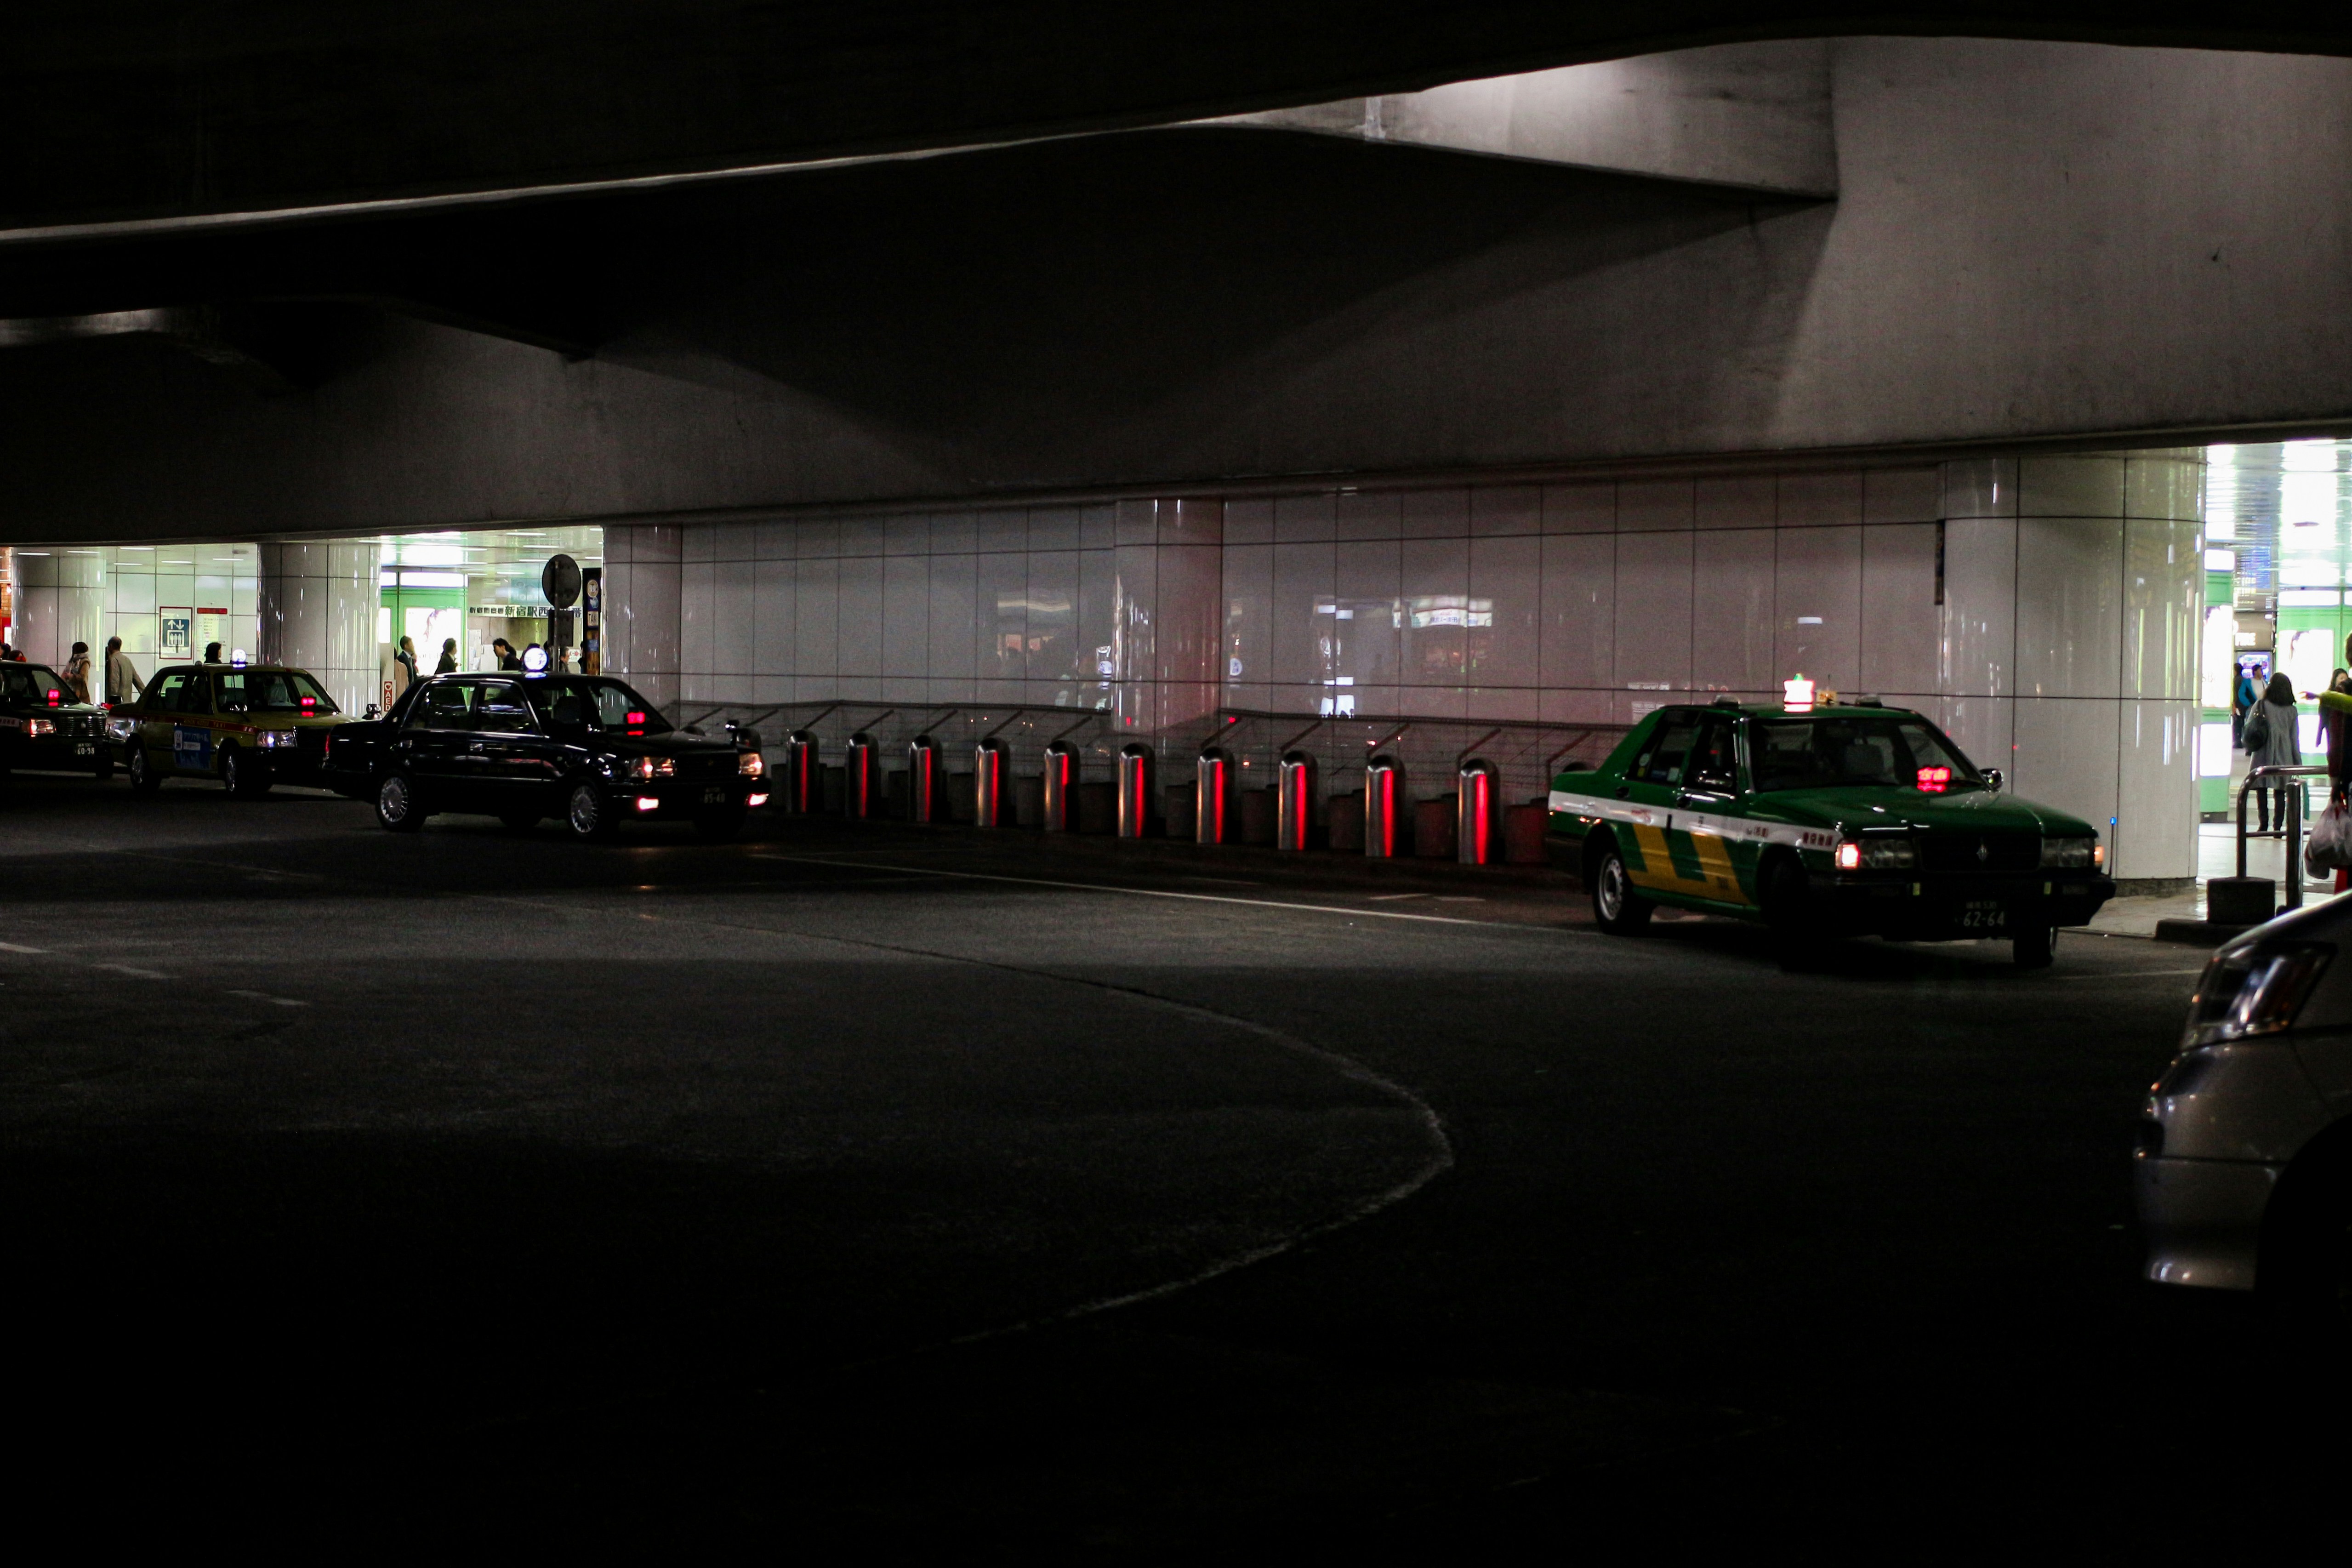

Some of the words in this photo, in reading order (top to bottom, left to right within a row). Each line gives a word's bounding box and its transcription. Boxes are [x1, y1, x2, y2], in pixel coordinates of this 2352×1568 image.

[505, 605, 581, 618] 新宿駅西番
[1963, 911, 2006, 927] 62-64
